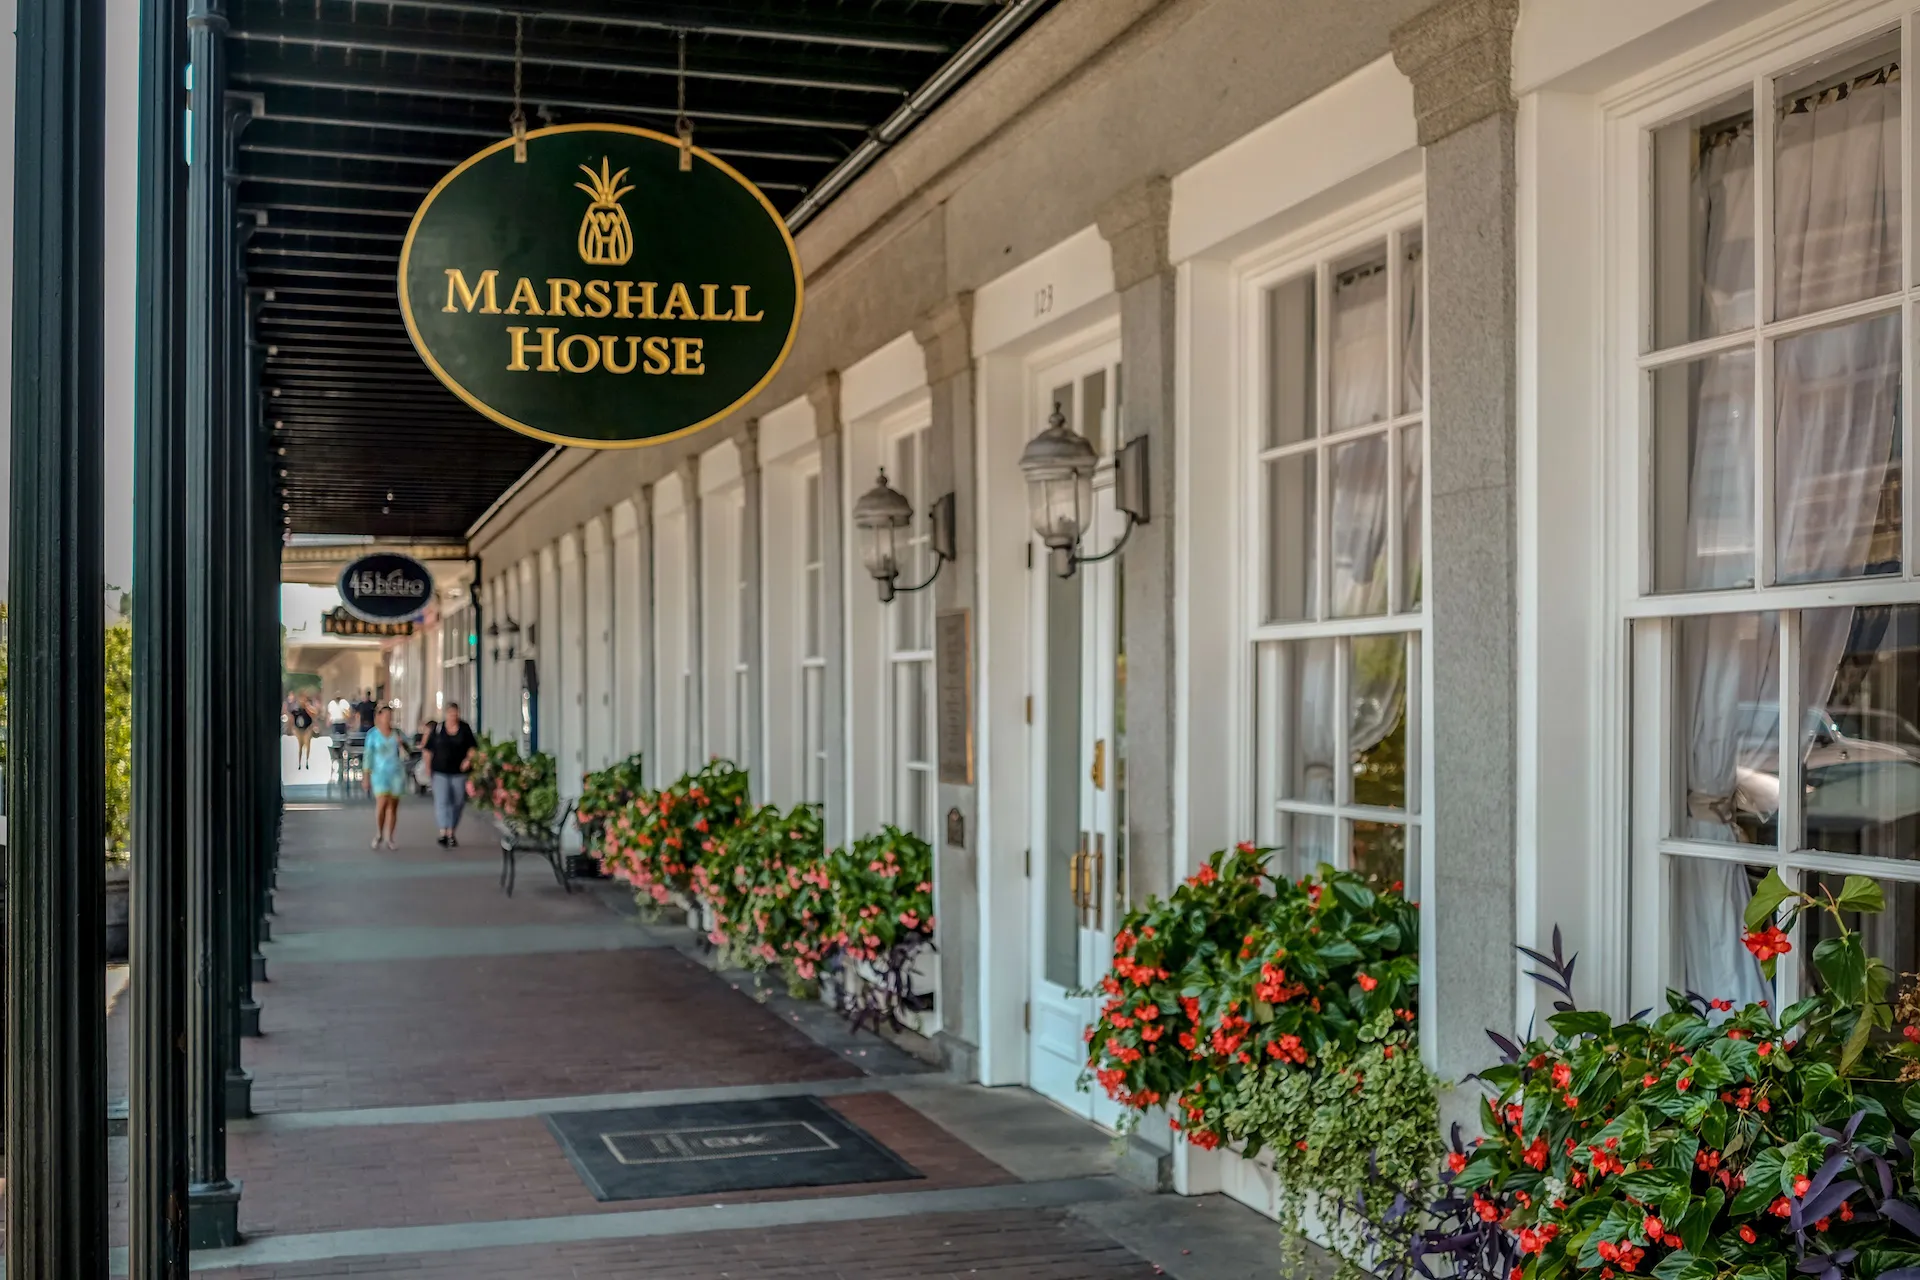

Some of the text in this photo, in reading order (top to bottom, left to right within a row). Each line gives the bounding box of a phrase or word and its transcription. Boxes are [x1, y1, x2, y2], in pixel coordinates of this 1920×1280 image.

[441, 268, 765, 322] MARSHALL
[1033, 284, 1054, 319] 123
[505, 326, 706, 376] HOUSE
[348, 569, 374, 599] 45
